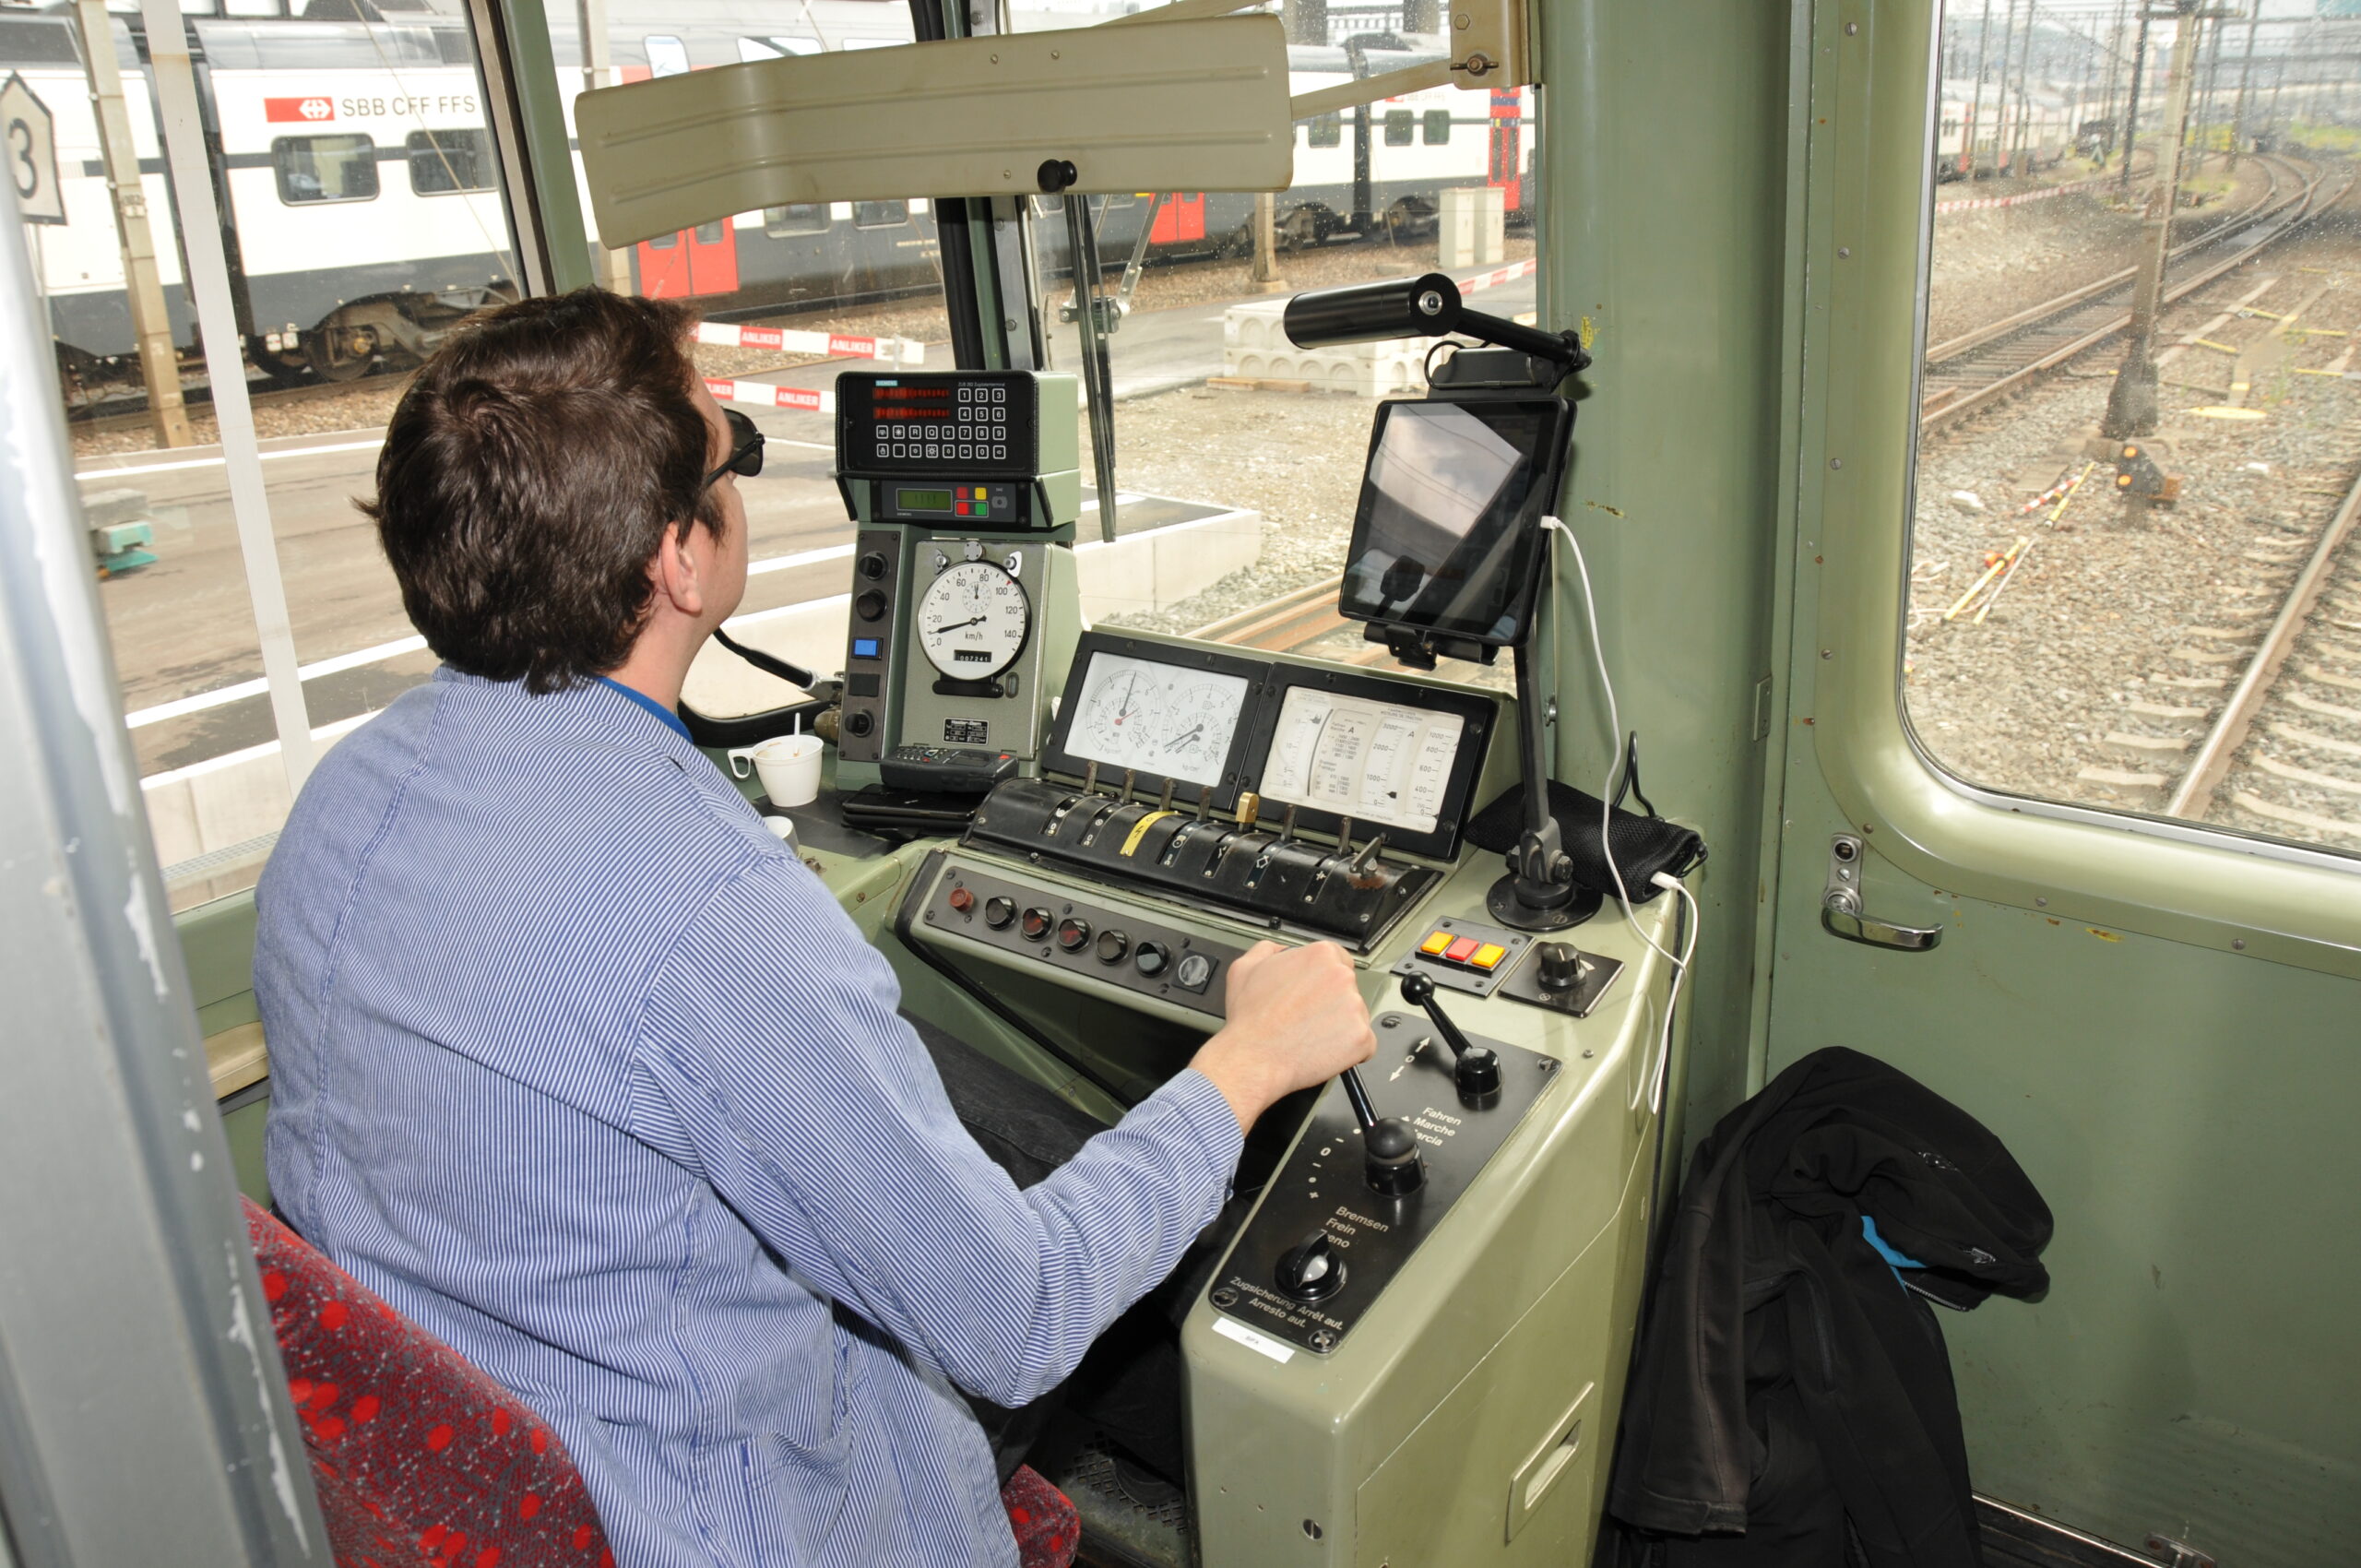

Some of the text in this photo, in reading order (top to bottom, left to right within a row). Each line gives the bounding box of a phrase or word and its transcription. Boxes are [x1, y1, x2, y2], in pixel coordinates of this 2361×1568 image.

[342, 95, 475, 117] SBB CFF FFS
[8, 117, 38, 199] 3
[742, 331, 781, 345] ANLIKER
[831, 340, 873, 354] ANLIKER
[777, 393, 819, 407] ANLIKER
[955, 578, 967, 587] 60
[979, 574, 990, 582] 80
[939, 592, 950, 601] 40
[995, 587, 1008, 596] 100
[1005, 606, 1017, 614] 120
[932, 615, 943, 624] 20
[965, 631, 983, 641] km/h
[1004, 630, 1016, 638] 140
[936, 637, 942, 647] 0
[1429, 731, 1444, 740] 1000
[1373, 743, 1388, 752] 2000
[1366, 774, 1381, 782] 1000
[1414, 785, 1428, 793] 400
[1405, 1055, 1415, 1063] 0
[1422, 1107, 1462, 1126] Fahren
[1413, 1117, 1456, 1137] Marche
[1414, 1128, 1443, 1146] arcia
[1320, 1146, 1331, 1157] 0
[1335, 1206, 1389, 1232] Bremsen
[1325, 1218, 1357, 1236] Frein
[1229, 1277, 1344, 1330] Zugsicherung Arrêt aut.
[1248, 1297, 1306, 1328] Arresto aut.
